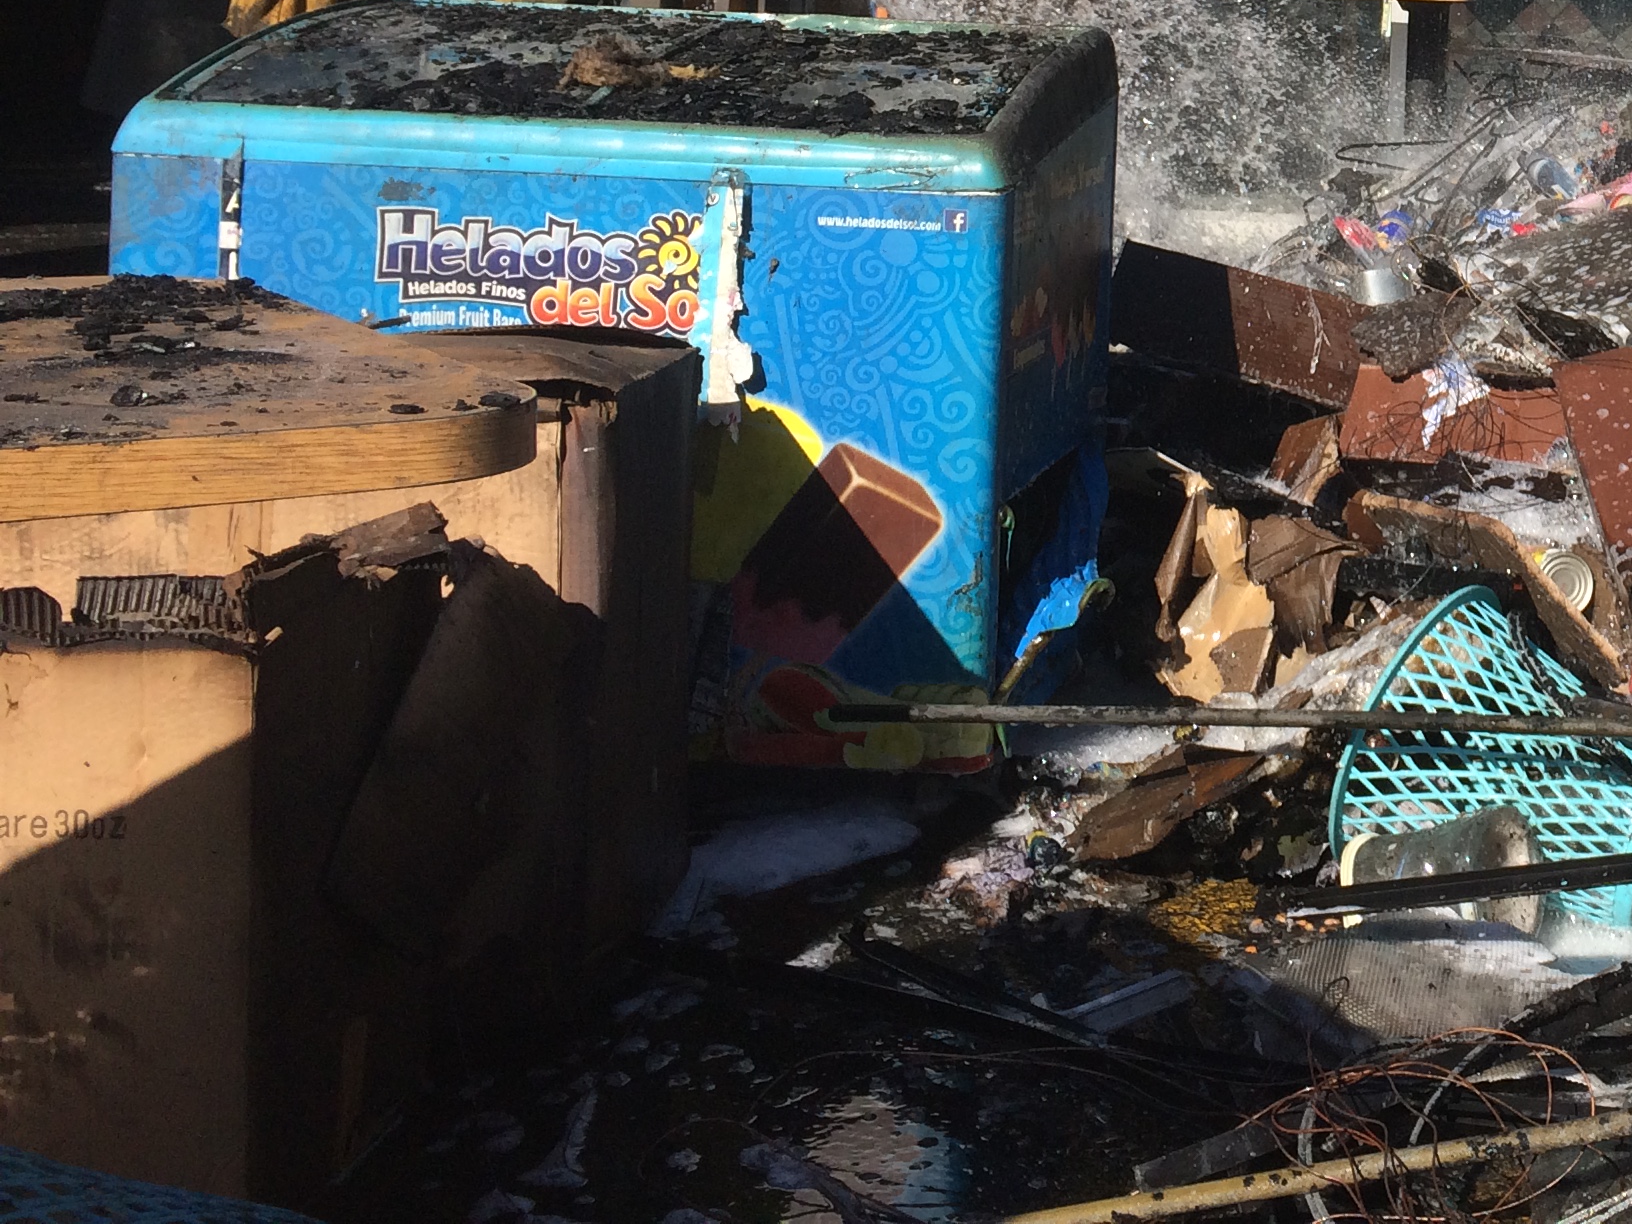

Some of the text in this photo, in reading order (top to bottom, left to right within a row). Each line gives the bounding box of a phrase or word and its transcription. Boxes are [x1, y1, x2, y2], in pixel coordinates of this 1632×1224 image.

[381, 211, 638, 283] Helados
[407, 279, 527, 301] Helados Finos
[529, 273, 700, 331] del So
[458, 305, 491, 327] Fruit
[0, 809, 127, 841] are30oz
